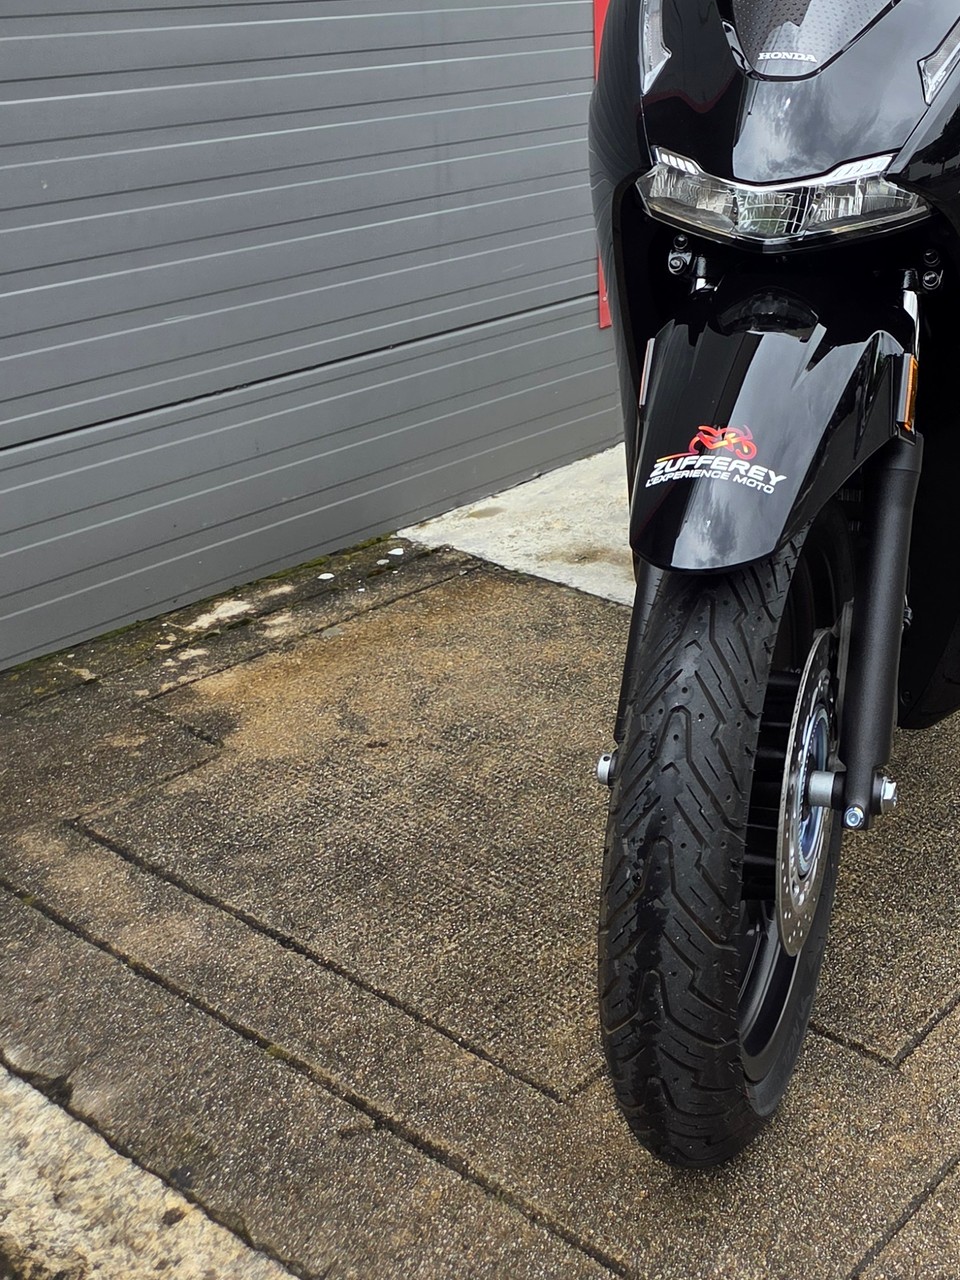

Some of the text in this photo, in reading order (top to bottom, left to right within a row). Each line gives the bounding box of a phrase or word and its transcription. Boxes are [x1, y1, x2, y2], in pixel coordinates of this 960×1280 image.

[757, 51, 818, 63] HONDA
[645, 469, 775, 495] L'EXPERIENCE MOTO
[650, 455, 787, 486] ZUFFEREY
